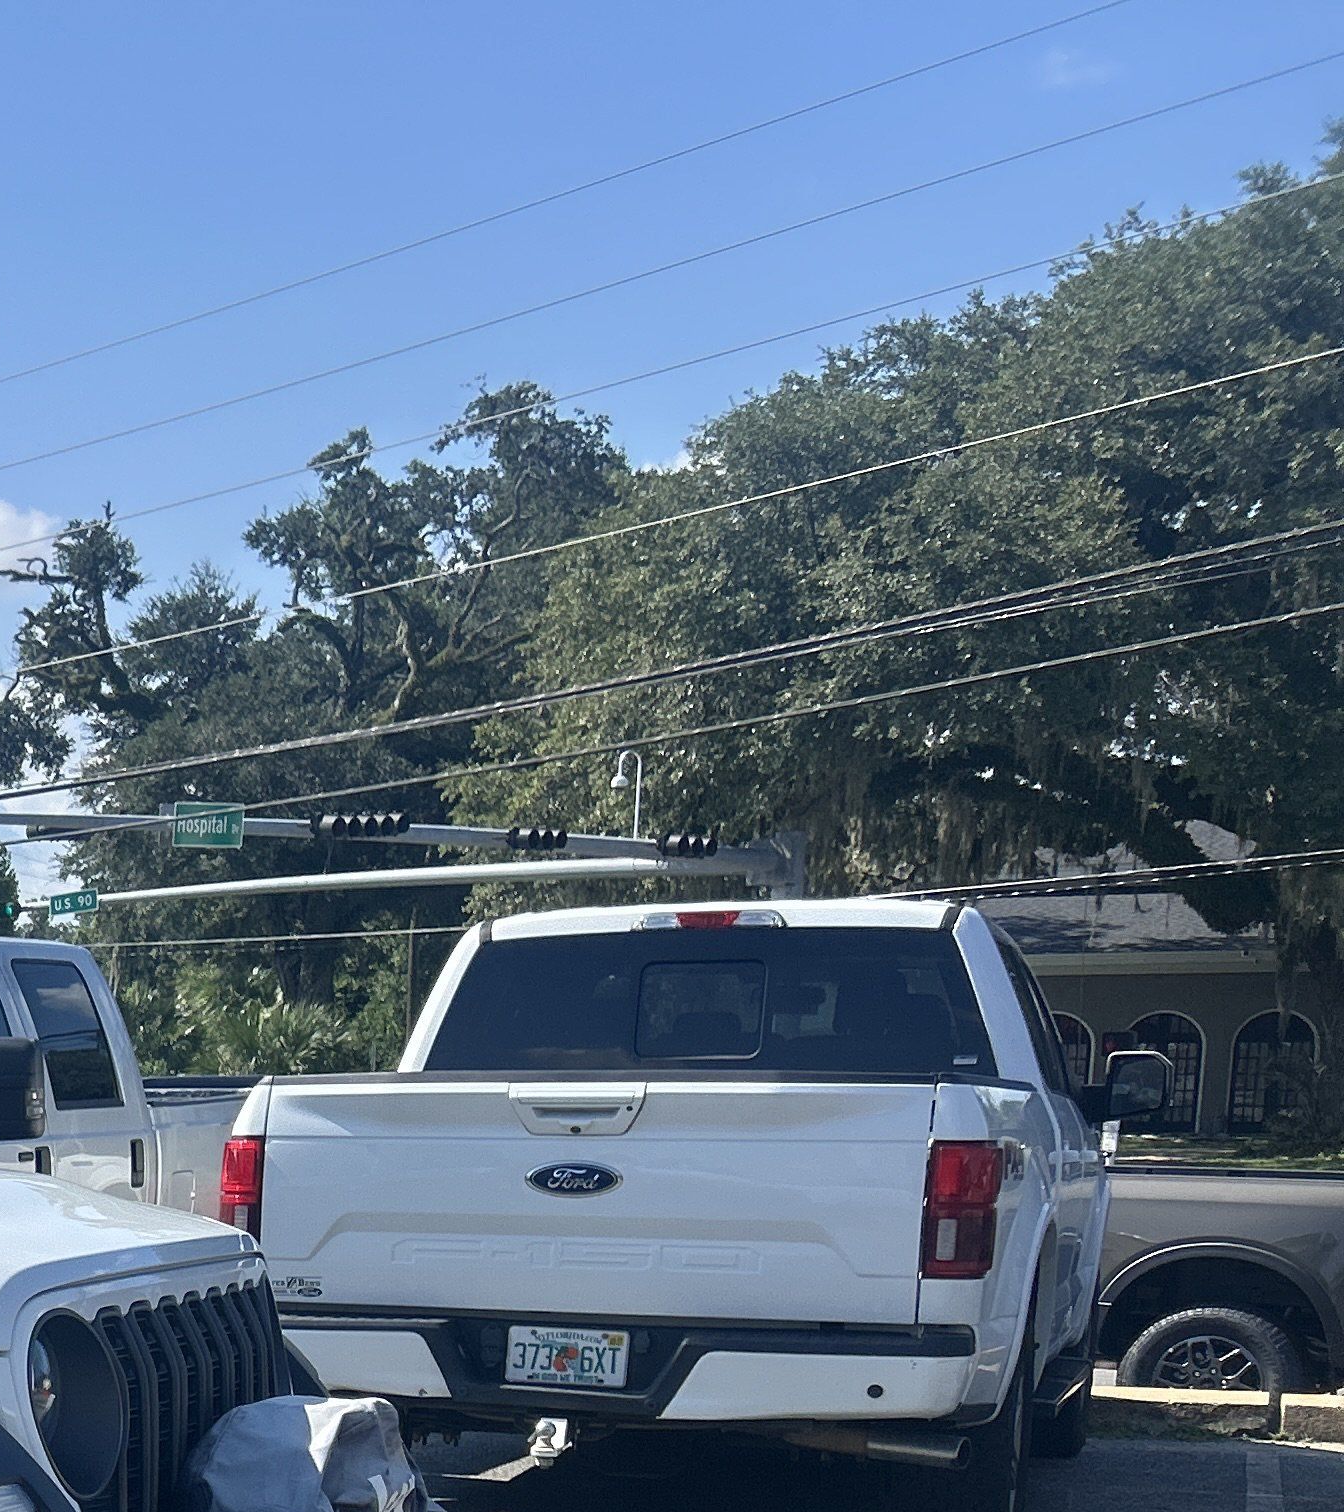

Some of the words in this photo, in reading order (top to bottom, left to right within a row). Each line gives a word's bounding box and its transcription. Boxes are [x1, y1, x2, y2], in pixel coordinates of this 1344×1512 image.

[177, 815, 228, 838] Hospital
[77, 894, 93, 907] 90
[547, 1167, 600, 1190] Ford
[391, 1238, 762, 1275] F-150
[513, 1342, 552, 1370] 373
[580, 1346, 621, 1374] 6XT
